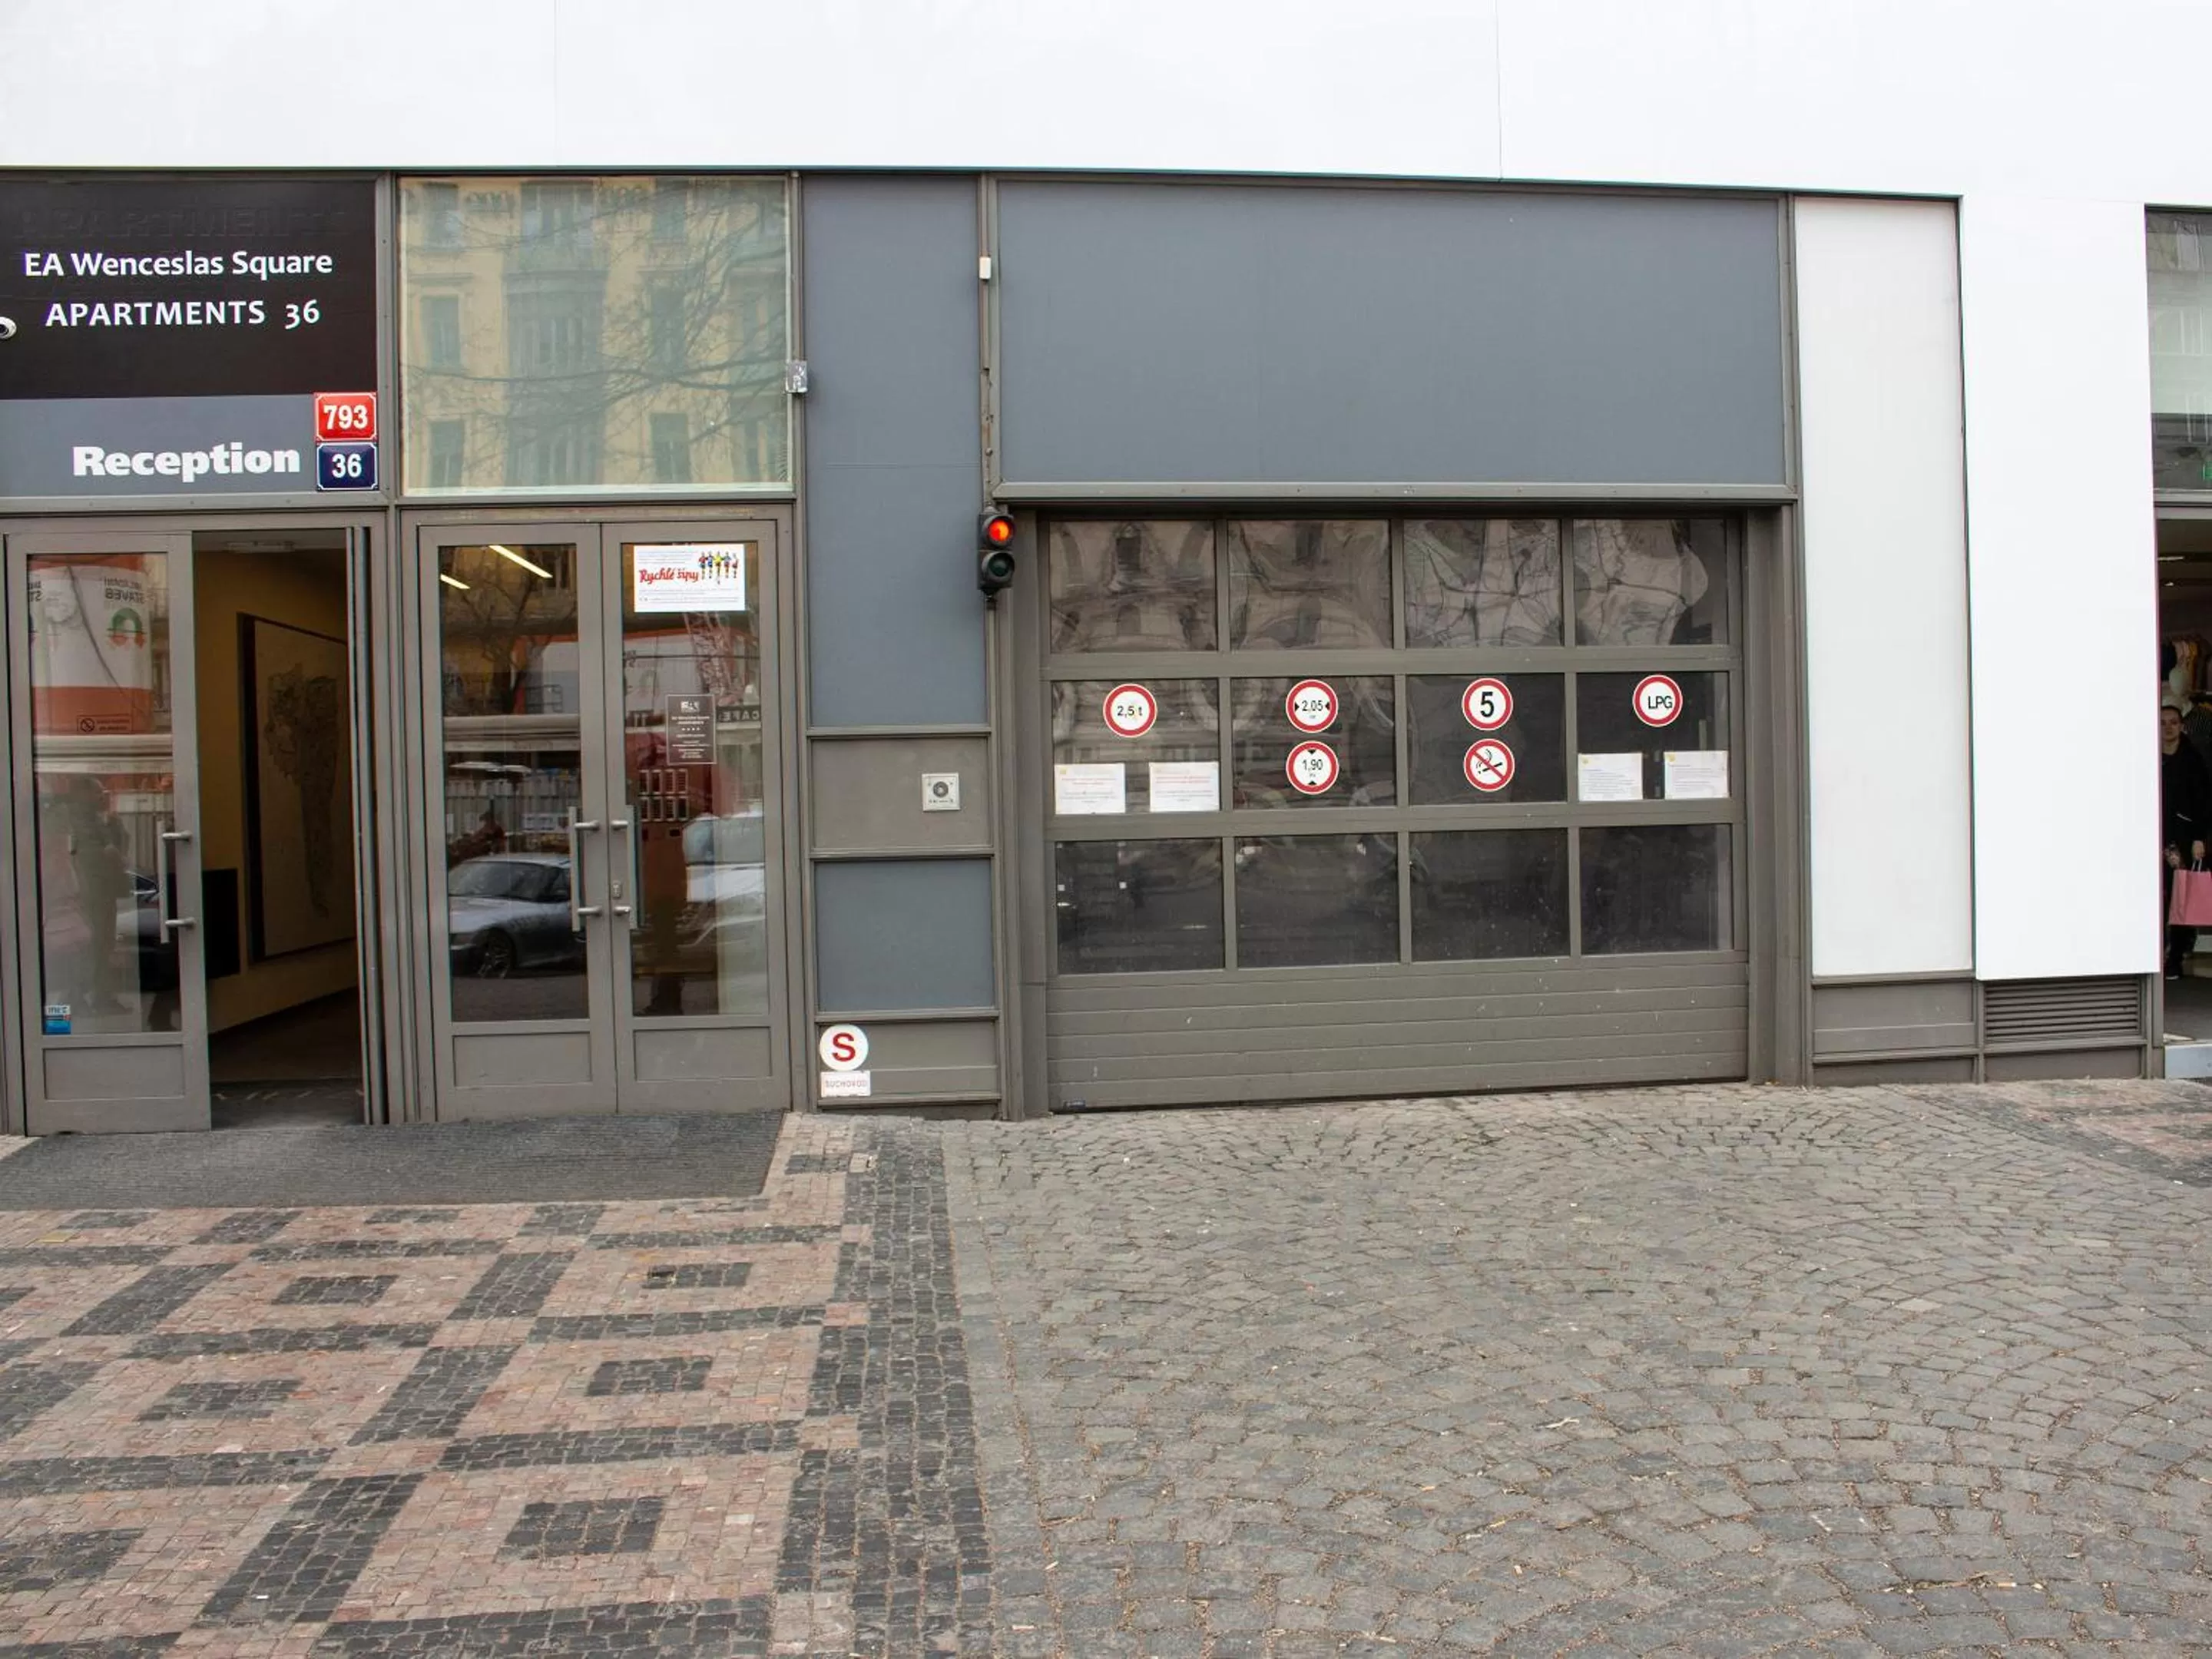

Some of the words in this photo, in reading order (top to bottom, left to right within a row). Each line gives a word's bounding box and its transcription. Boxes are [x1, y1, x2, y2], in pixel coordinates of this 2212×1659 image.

[24, 253, 64, 276] EA
[71, 250, 224, 276] Wenceslas
[232, 251, 333, 280] Square
[45, 300, 266, 326] APARTMENTS
[285, 300, 320, 329] 36
[323, 406, 369, 430] 793
[73, 442, 300, 482] Reception
[332, 454, 362, 478] 36
[1117, 706, 1135, 718] 2,5
[1479, 691, 1495, 717] 5
[1647, 695, 1674, 710] LPG
[832, 1032, 856, 1061] S
